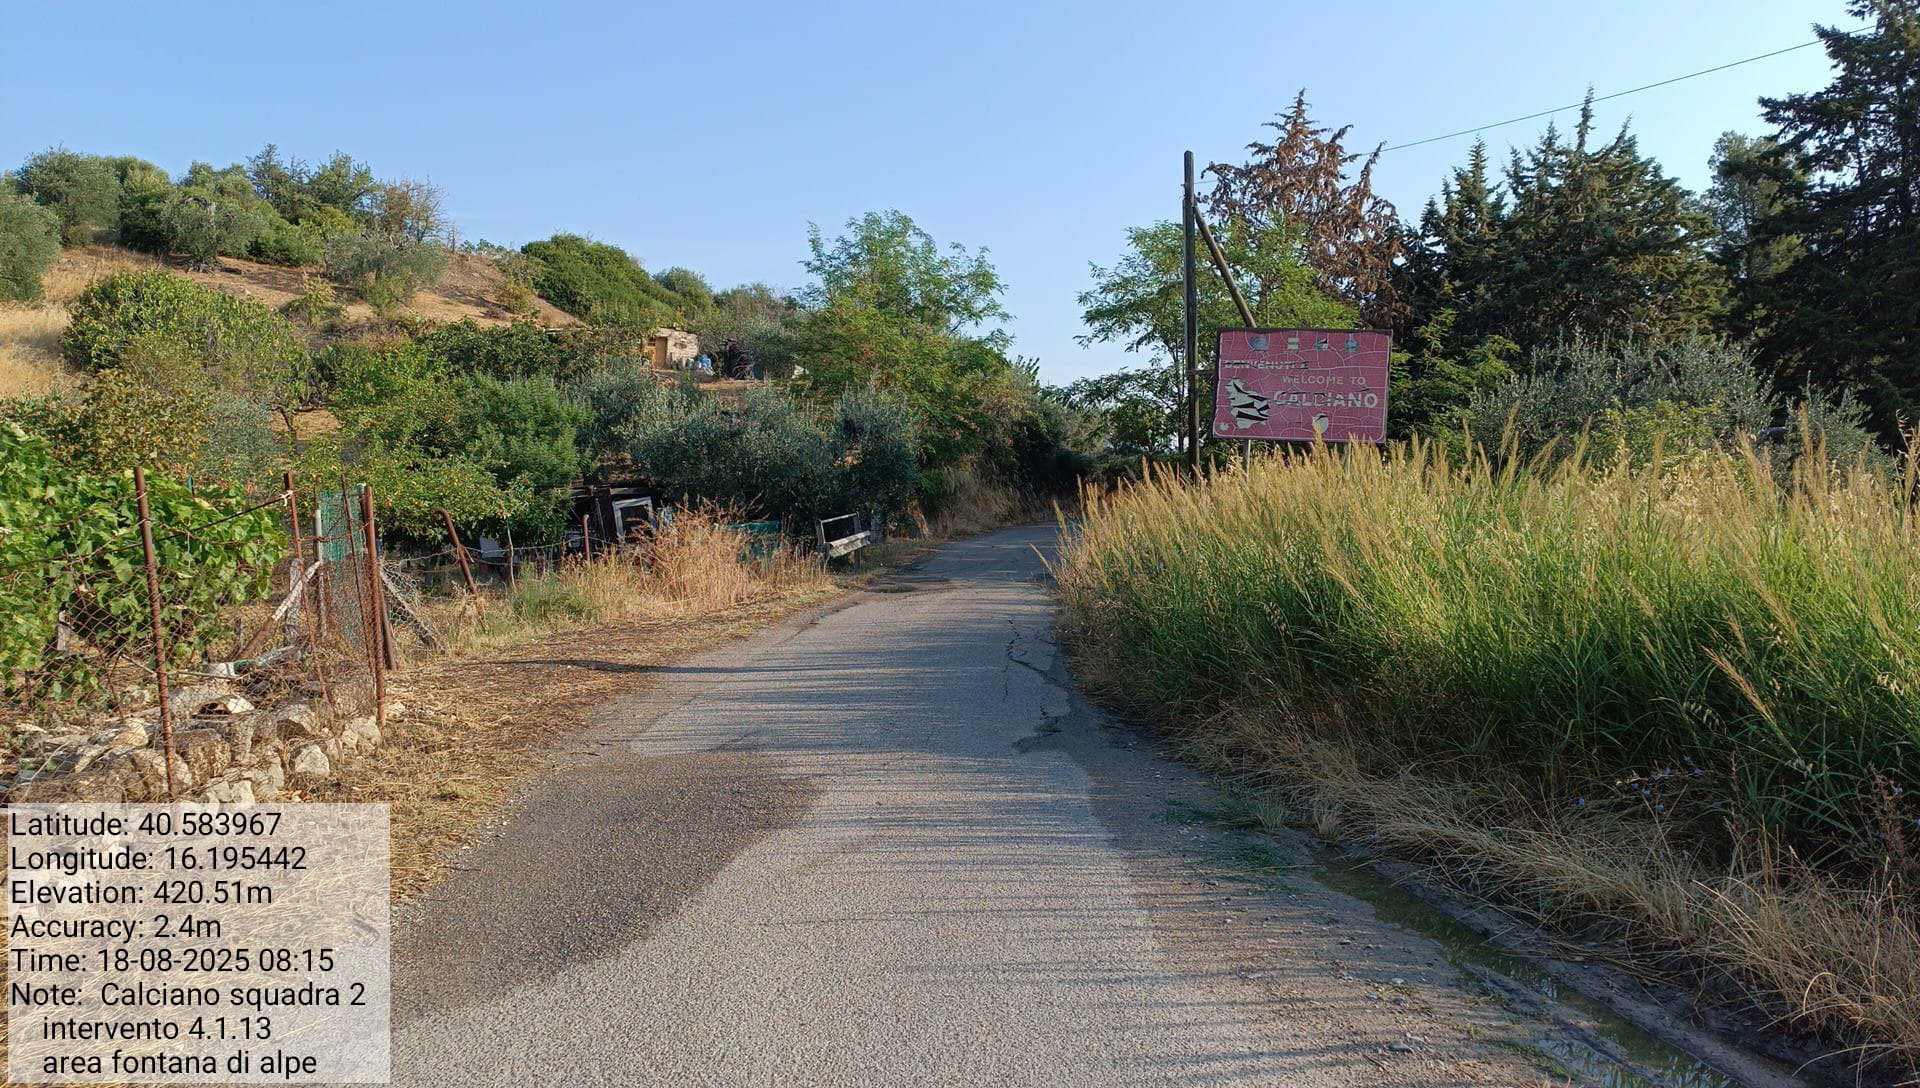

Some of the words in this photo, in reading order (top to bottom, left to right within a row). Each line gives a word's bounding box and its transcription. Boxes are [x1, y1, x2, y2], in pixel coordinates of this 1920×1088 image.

[1282, 375, 1344, 385] WELCOME
[1350, 376, 1366, 385] TO
[1273, 390, 1378, 409] CALCIANO
